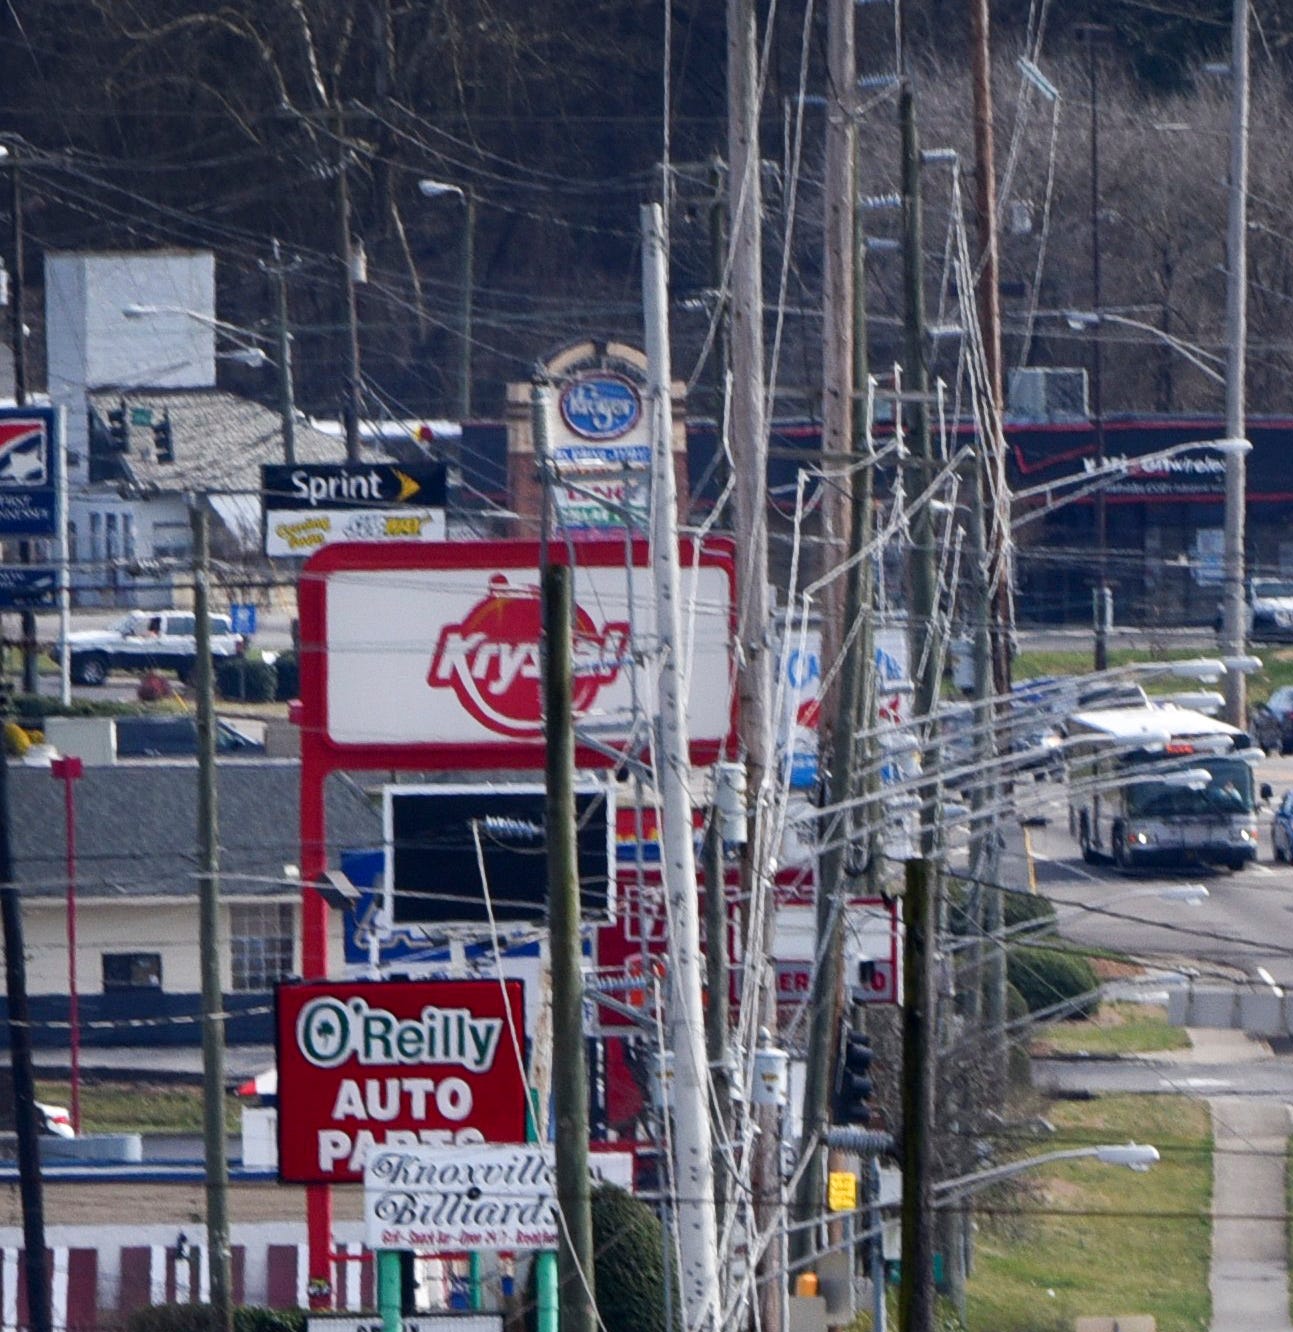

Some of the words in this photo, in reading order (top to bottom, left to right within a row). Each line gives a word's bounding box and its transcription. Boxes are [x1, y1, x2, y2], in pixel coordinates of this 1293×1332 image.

[291, 469, 383, 506] Sprint
[299, 999, 500, 1070] O'Reilly
[331, 1077, 473, 1120] AUTO
[374, 1191, 558, 1226] Billiards
